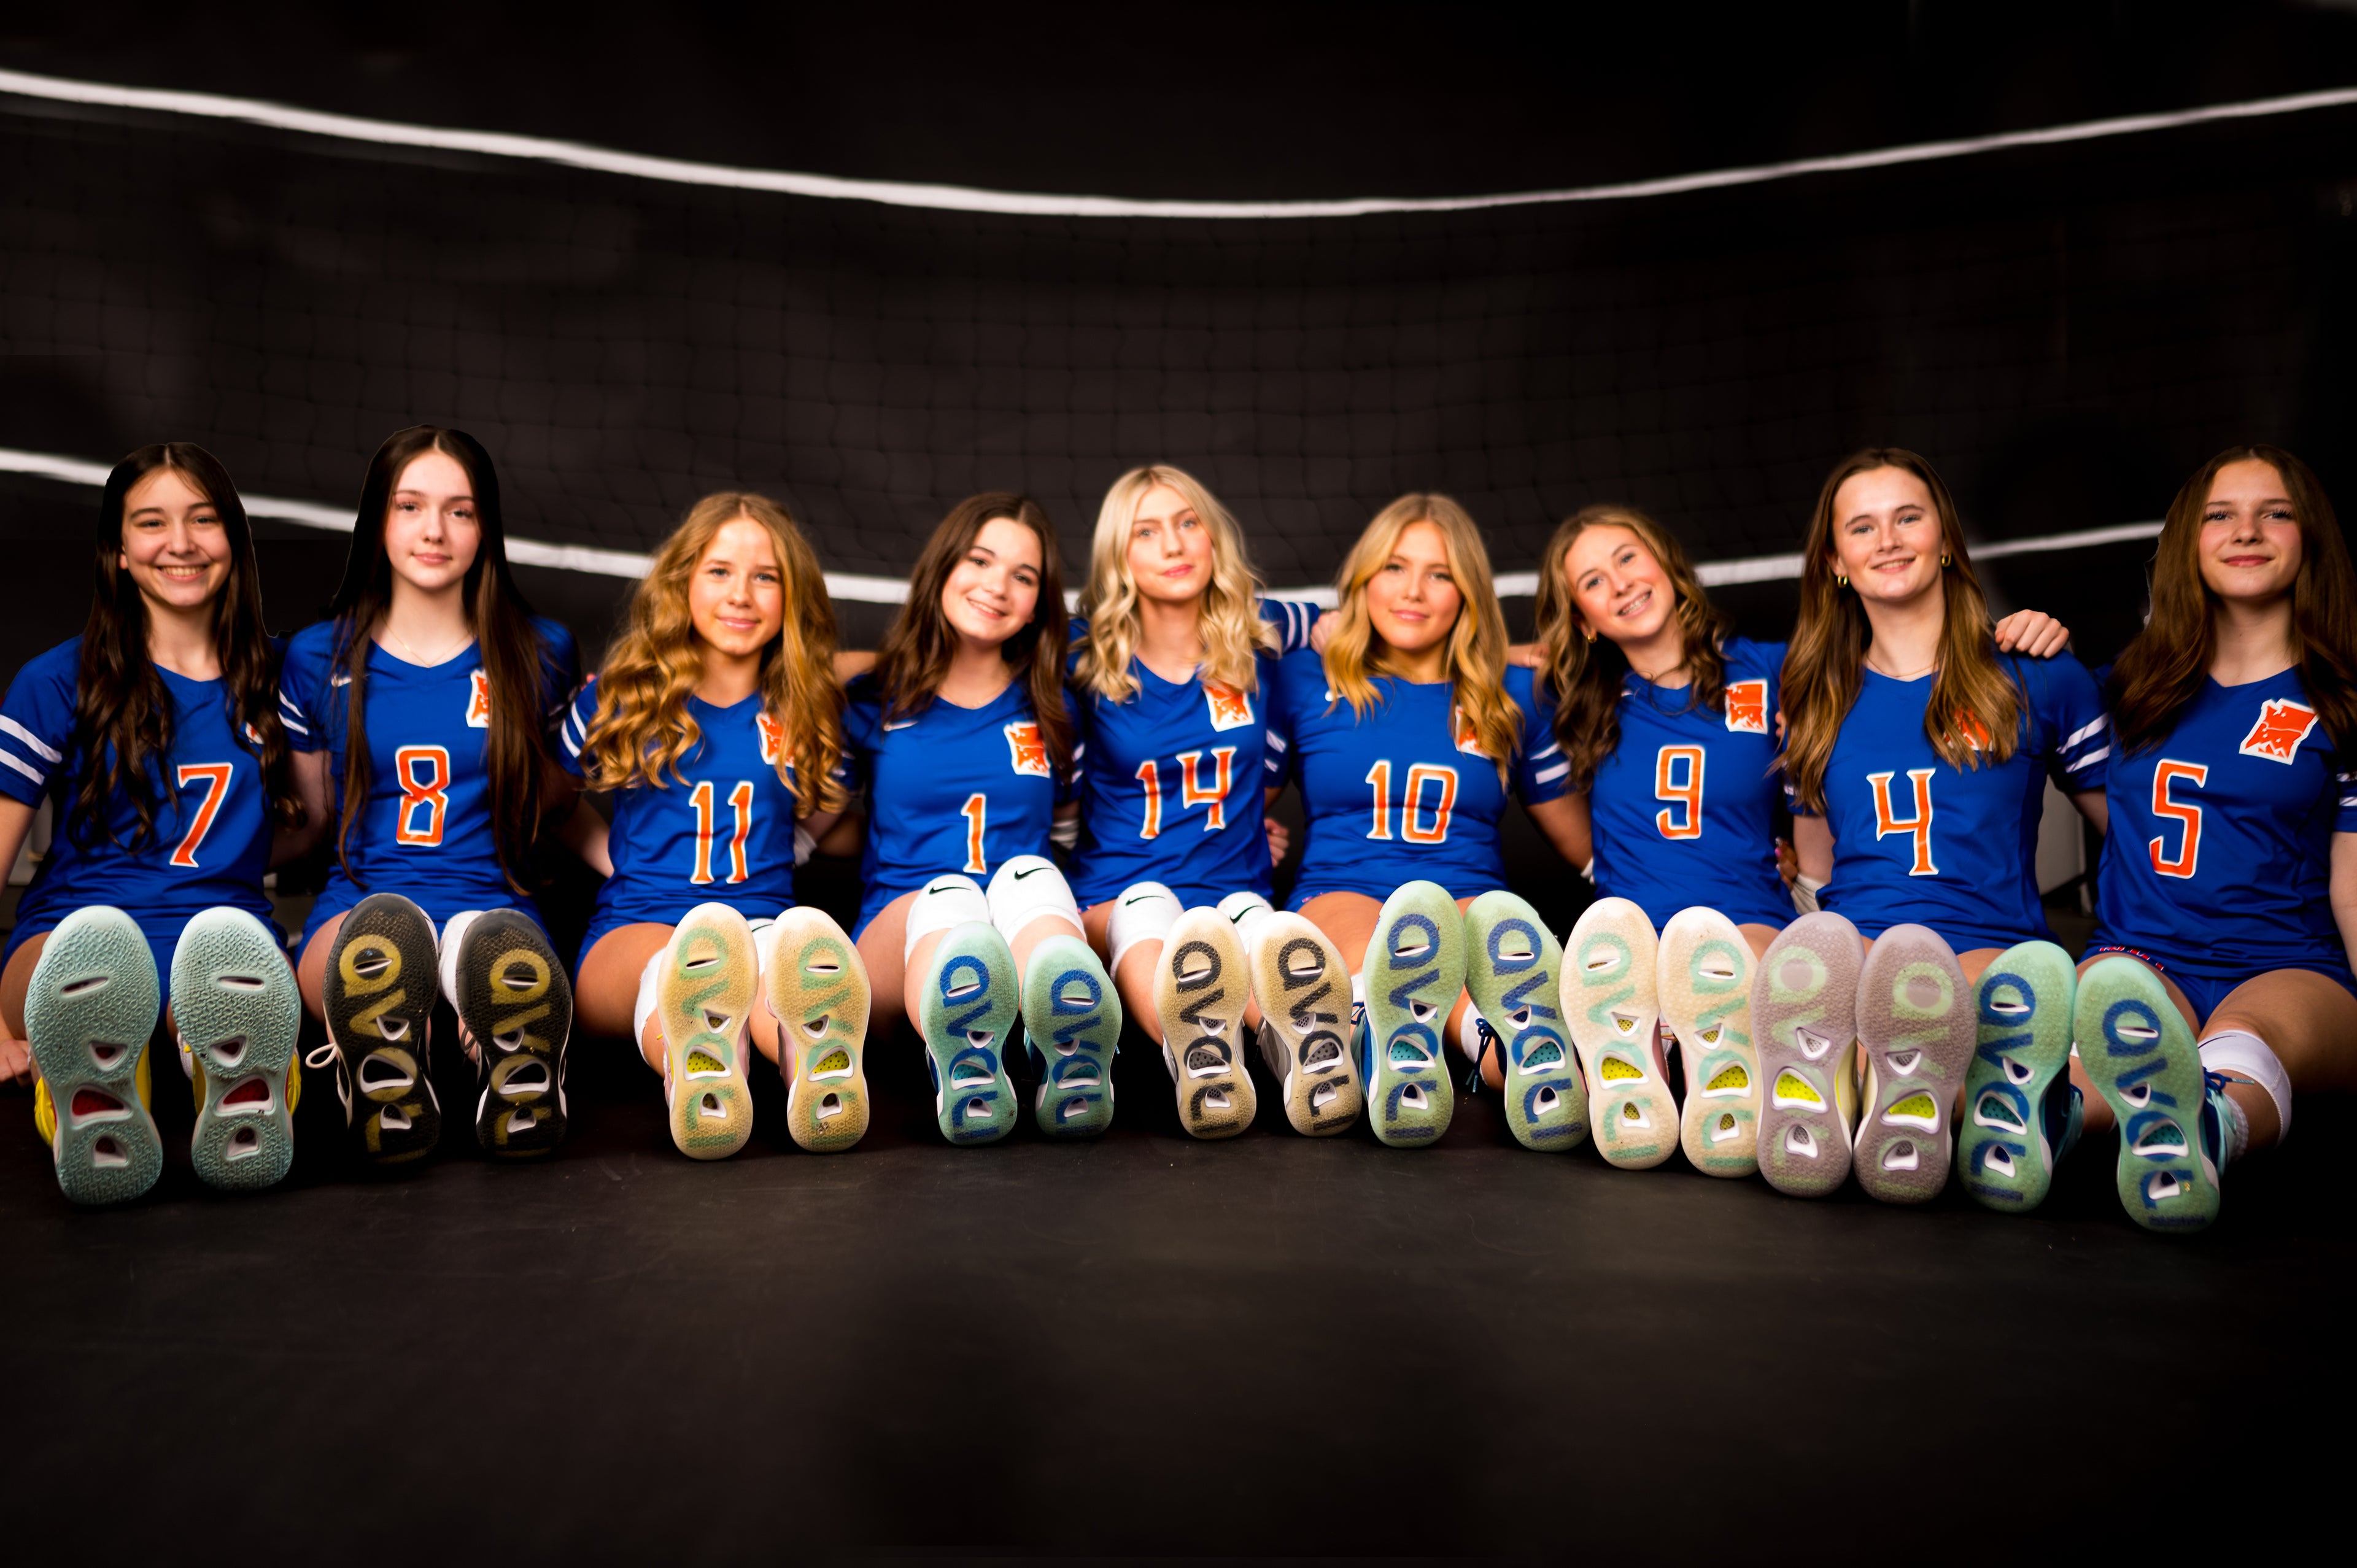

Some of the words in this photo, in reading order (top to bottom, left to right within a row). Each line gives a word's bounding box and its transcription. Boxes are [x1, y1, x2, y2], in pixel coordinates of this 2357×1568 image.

[169, 763, 233, 868] 7
[396, 745, 449, 846] 8
[688, 781, 754, 884] 11
[960, 793, 987, 875] 1
[1134, 746, 1237, 840] 14
[1365, 759, 1459, 844] 10
[1655, 744, 1705, 840] 9
[1866, 767, 1940, 876] 4
[2148, 759, 2208, 879] 5
